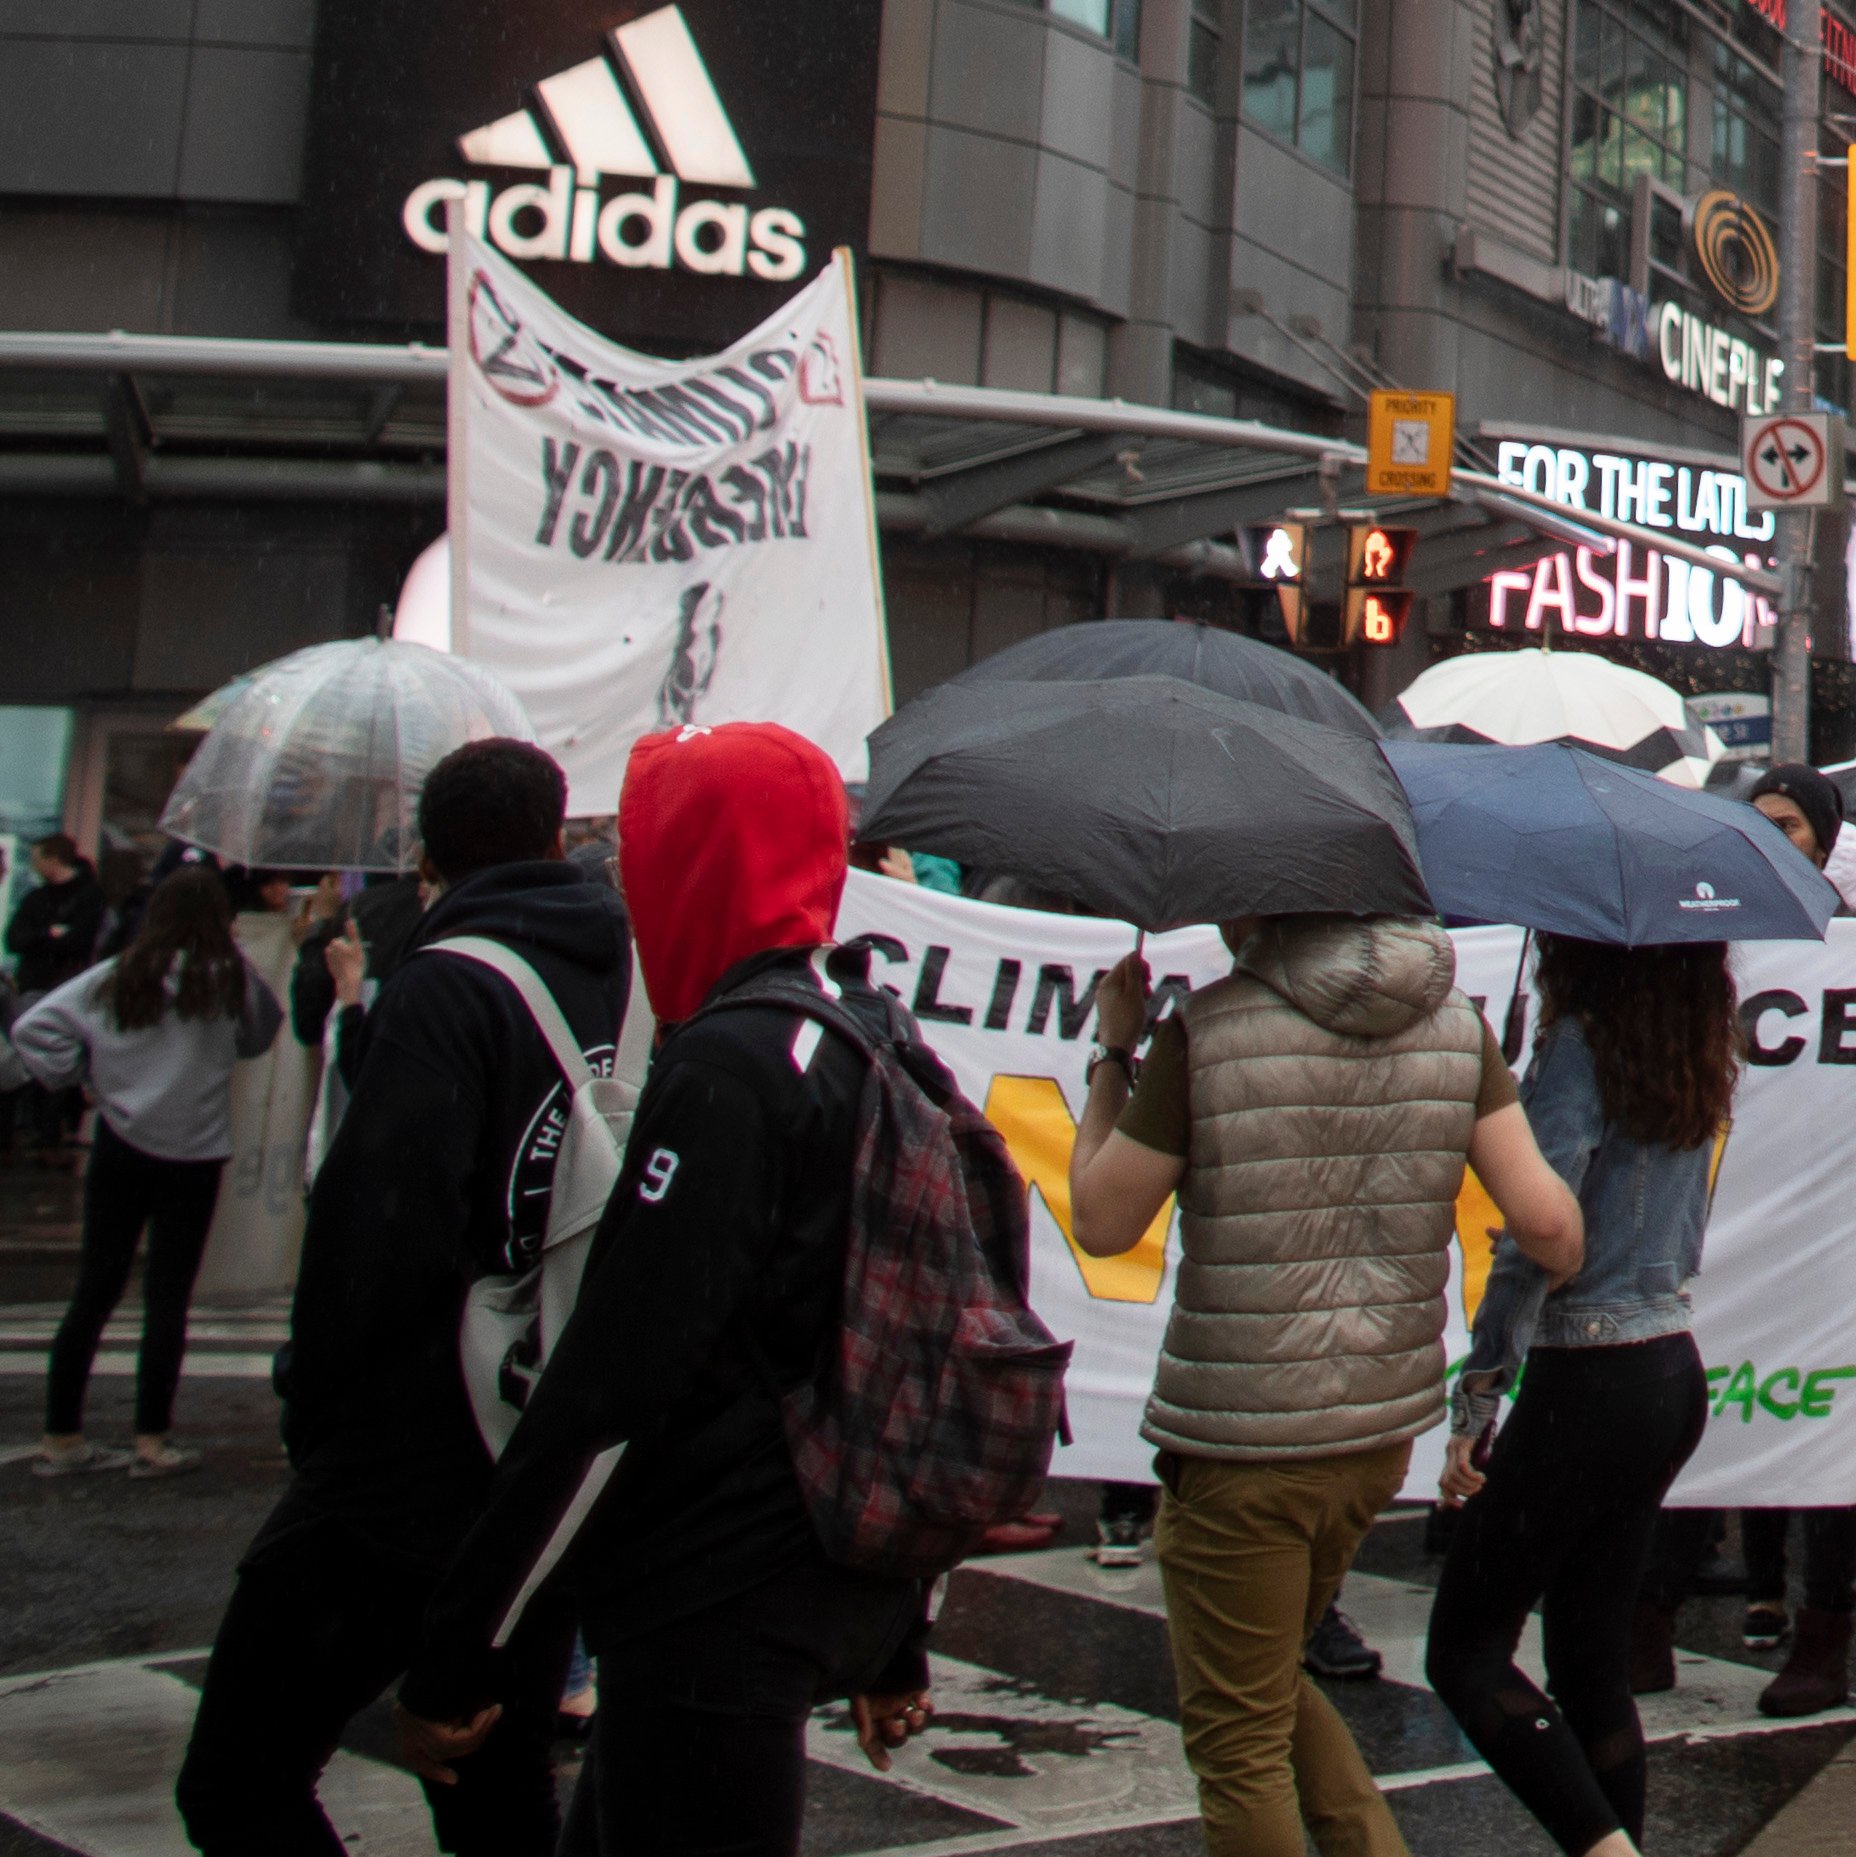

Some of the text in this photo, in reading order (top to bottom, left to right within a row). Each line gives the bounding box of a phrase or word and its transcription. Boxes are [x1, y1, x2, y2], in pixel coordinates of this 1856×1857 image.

[402, 164, 808, 281] adidas
[1498, 441, 1590, 510] FOR
[1592, 454, 1675, 527] THE
[529, 1108, 567, 1161] THE
[639, 1147, 681, 1202] 9
